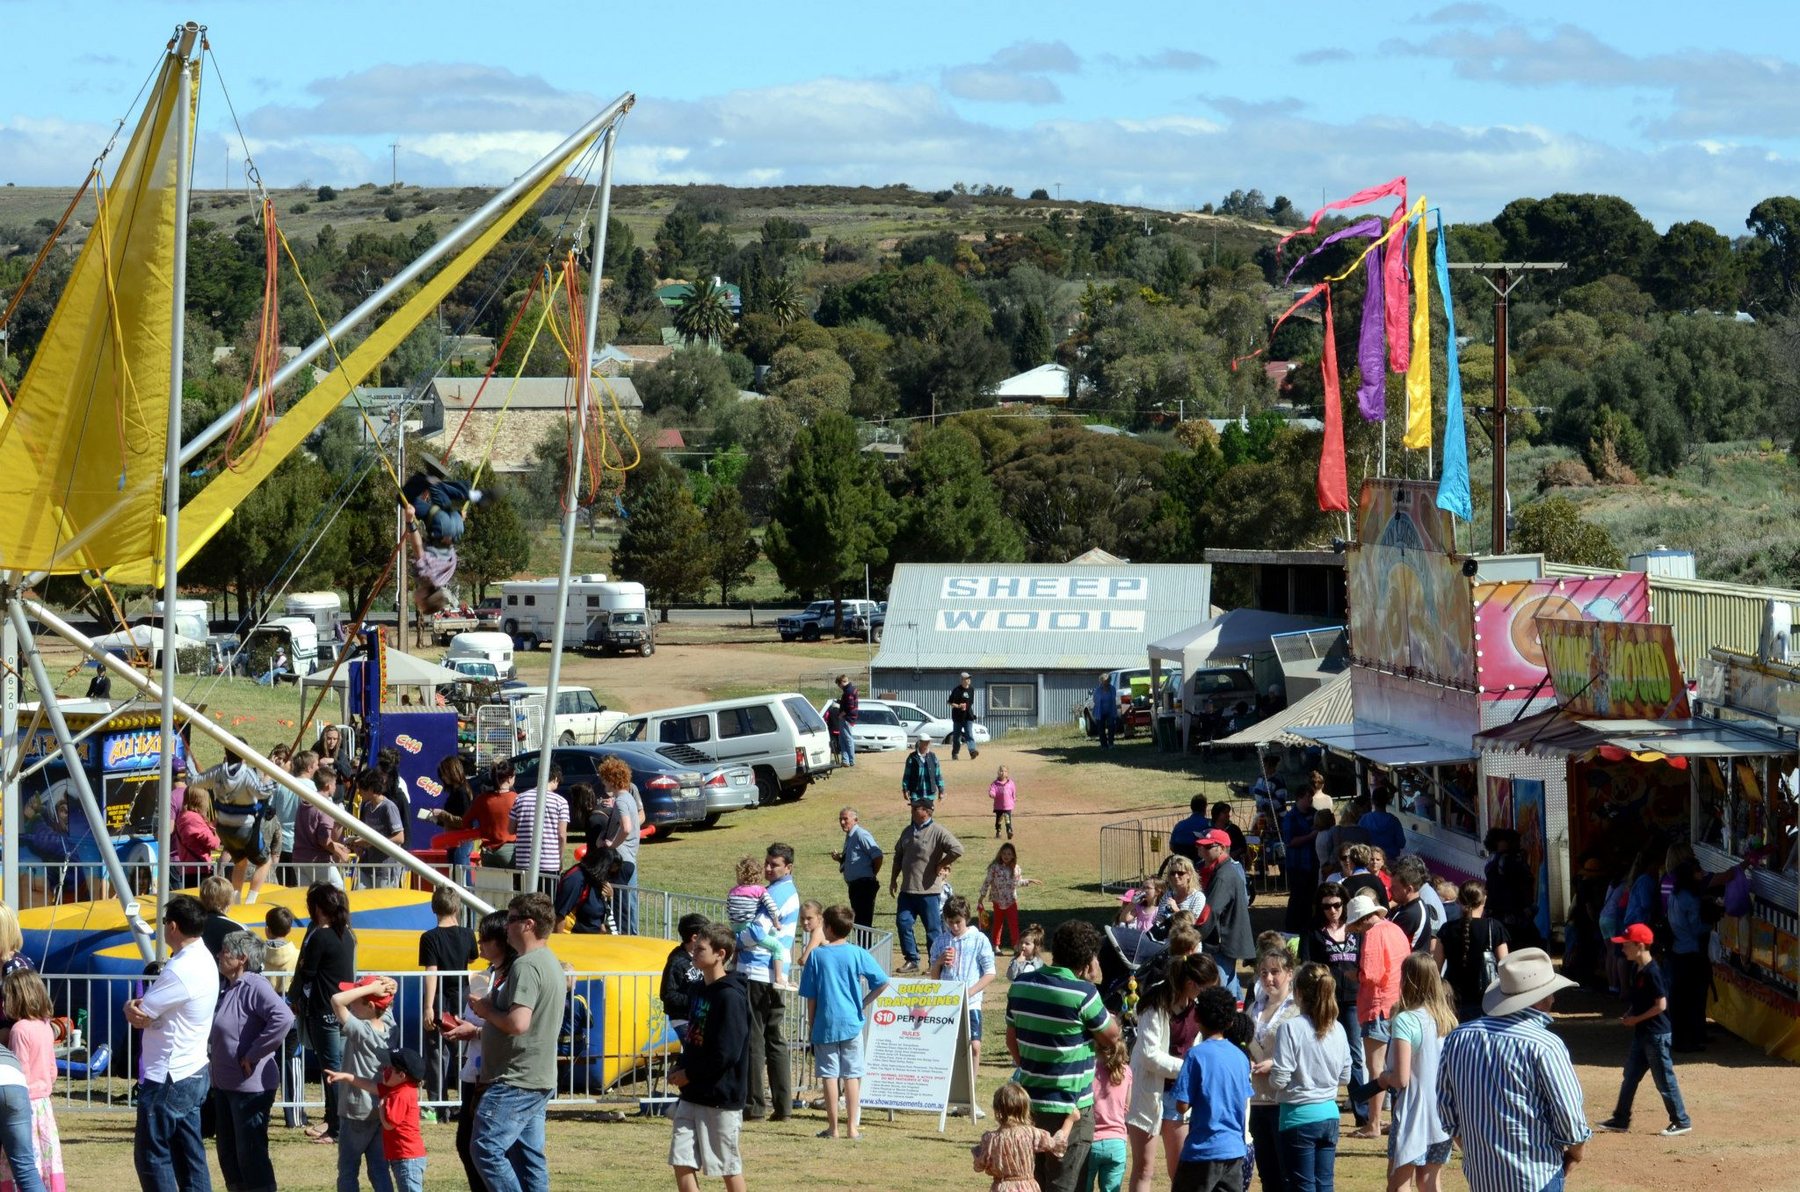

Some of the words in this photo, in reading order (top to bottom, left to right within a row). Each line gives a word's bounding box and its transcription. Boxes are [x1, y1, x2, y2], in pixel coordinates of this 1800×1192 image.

[946, 577, 1142, 598] SHEEP
[943, 610, 1139, 631] WOOL
[44, 735, 88, 761] BA
[109, 736, 134, 766] ALI
[137, 735, 175, 756] BA
[898, 984, 941, 994] BUNGY
[877, 996, 959, 1007] TRAMPOLINES
[876, 1011, 894, 1023] $10
[897, 1014, 914, 1023] PER
[917, 1014, 954, 1025] PERSON
[860, 1098, 944, 1109] www.showamusements.com.au
